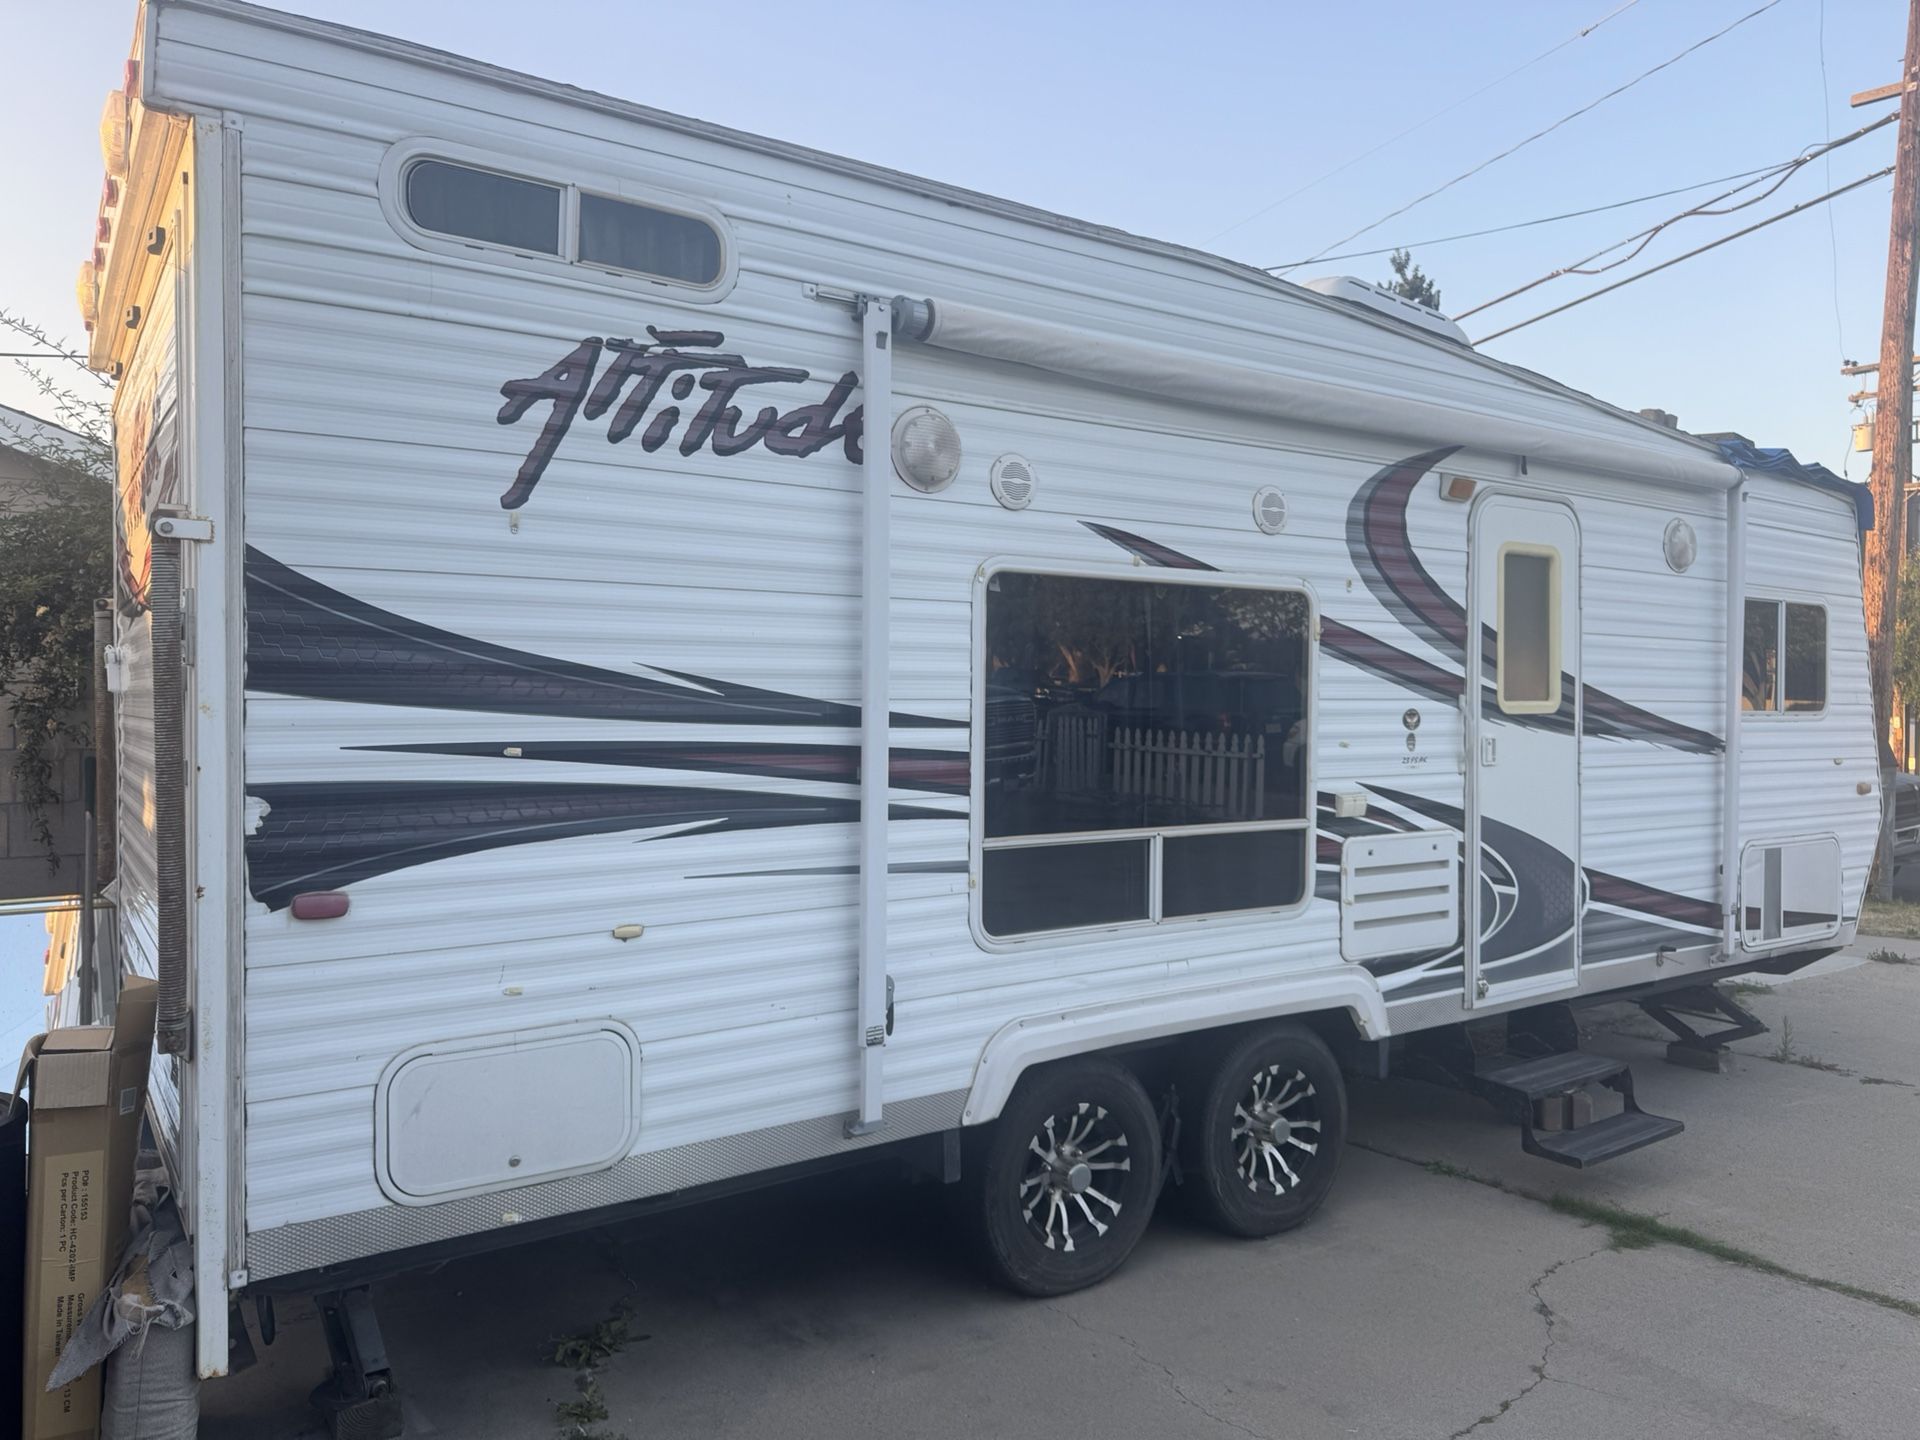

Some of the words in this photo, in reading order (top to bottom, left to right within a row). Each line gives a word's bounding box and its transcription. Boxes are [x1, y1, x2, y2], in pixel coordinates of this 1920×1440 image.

[61, 1172, 69, 1187] Pcs
[71, 1171, 80, 1202] Product
[60, 1203, 68, 1233] Carton:
[70, 1203, 78, 1227] Code:
[59, 1240, 67, 1253] PC
[77, 1292, 85, 1317] Gross
[55, 1329, 63, 1357] Taiwan
[64, 1399, 71, 1414] CM
